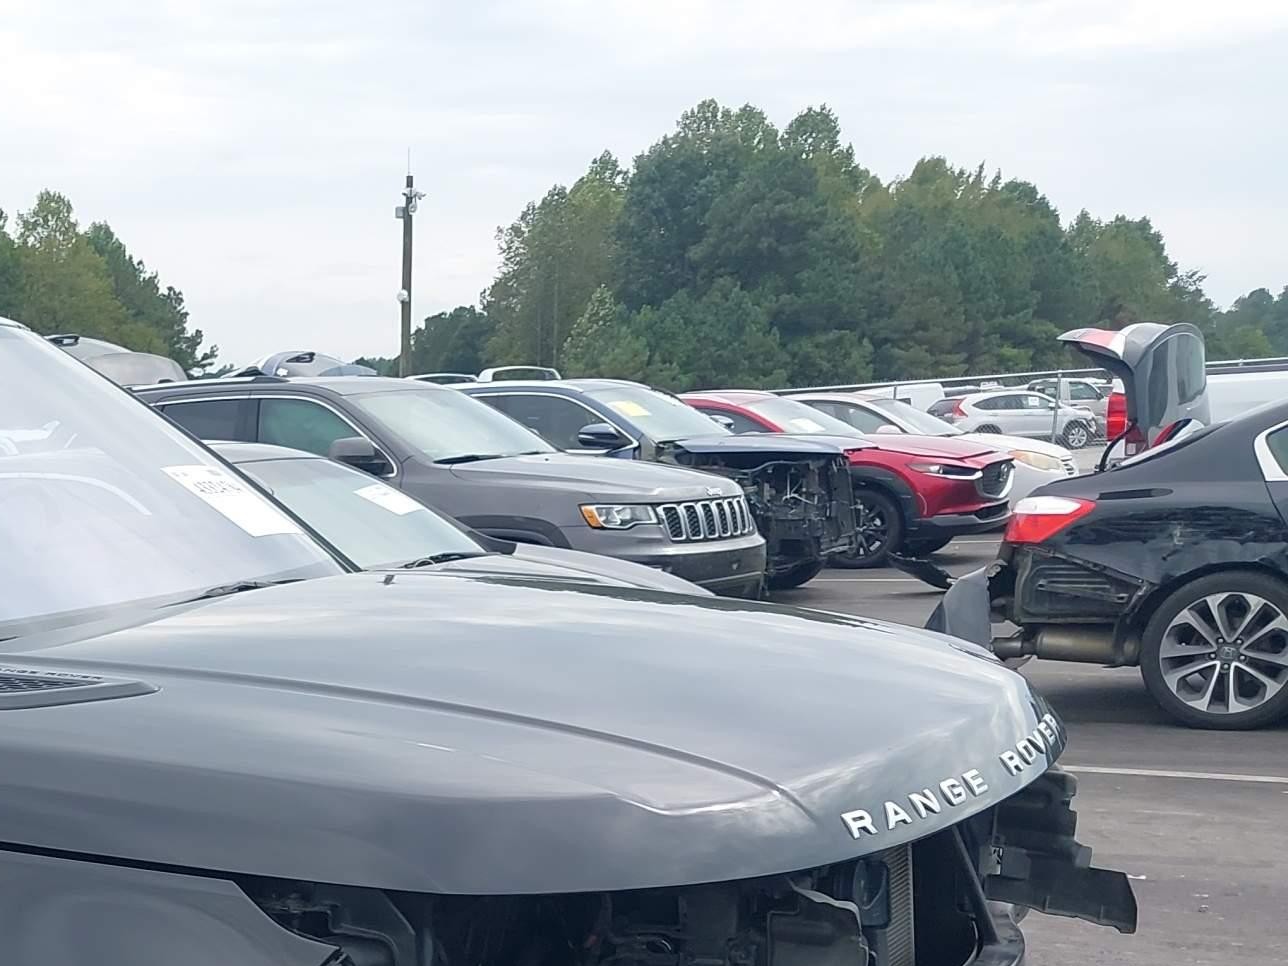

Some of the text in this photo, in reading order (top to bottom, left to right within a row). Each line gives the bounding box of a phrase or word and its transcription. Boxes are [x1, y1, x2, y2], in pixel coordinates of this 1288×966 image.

[45, 672, 103, 680] ROVER
[841, 713, 1061, 839] RANGE ROVER
